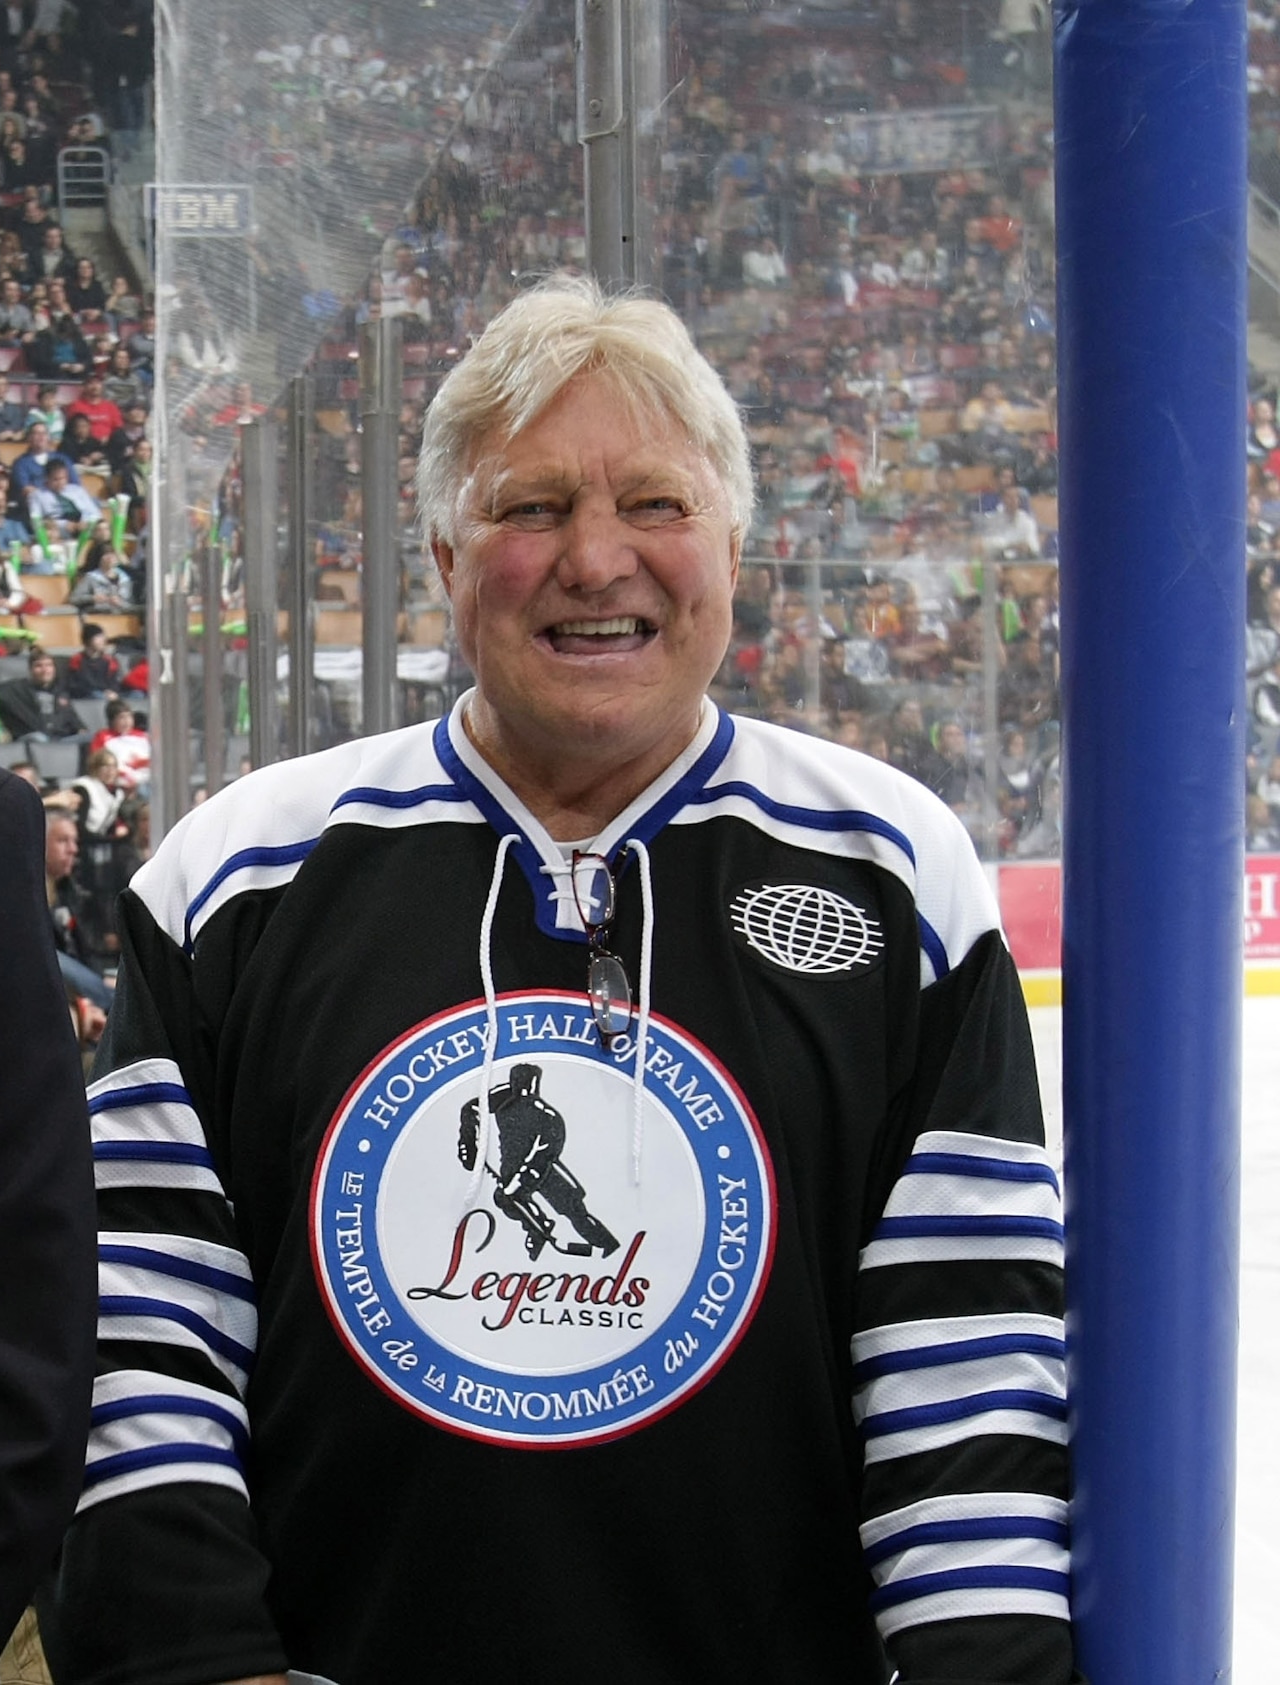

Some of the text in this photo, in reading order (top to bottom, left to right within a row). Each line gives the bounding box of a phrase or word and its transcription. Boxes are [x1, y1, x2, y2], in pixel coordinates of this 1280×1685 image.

[160, 193, 239, 229] IBM
[365, 1022, 493, 1130] HOCKEY
[507, 1013, 597, 1045] HALL
[644, 1042, 725, 1131] FAME
[336, 1171, 749, 1421] LE TEMPLE de LA RENOMMÉE du HOCKEY
[406, 1208, 651, 1331] Legends
[518, 1307, 644, 1330] CLASSIC
